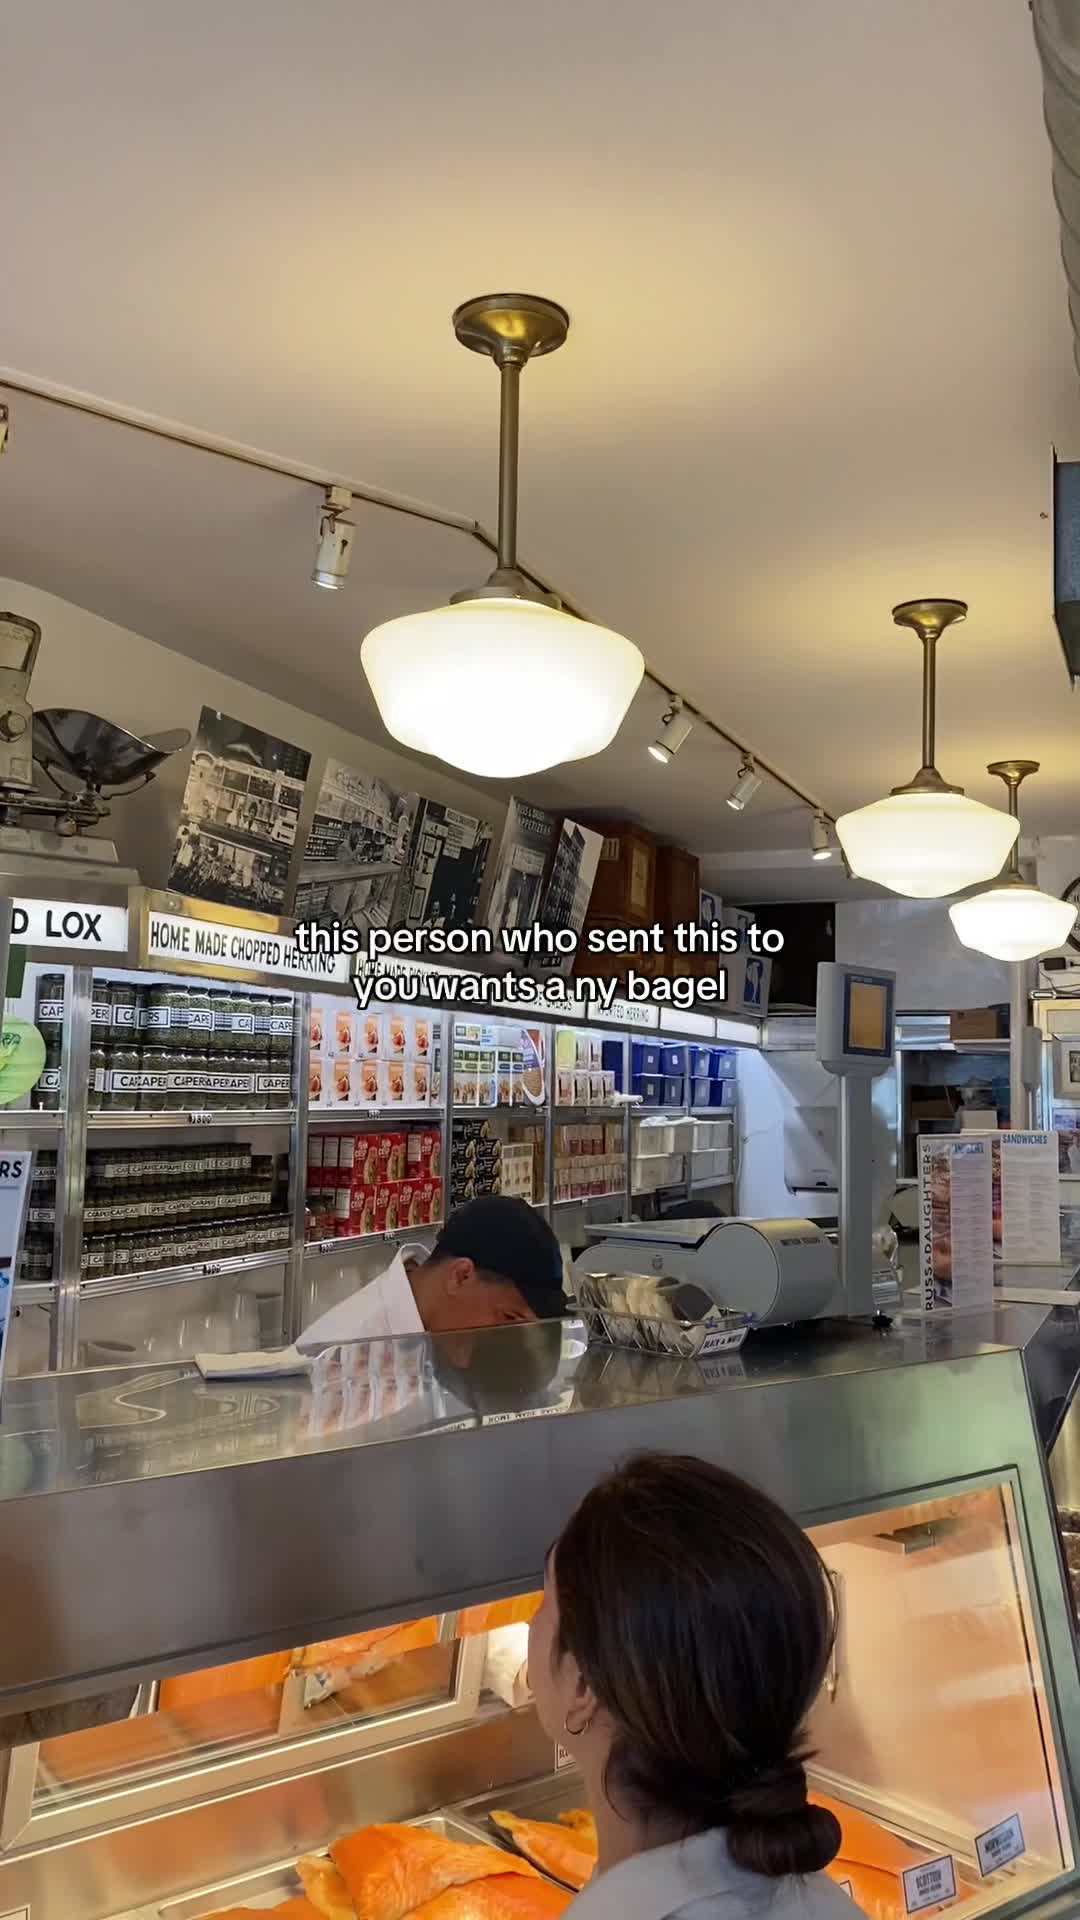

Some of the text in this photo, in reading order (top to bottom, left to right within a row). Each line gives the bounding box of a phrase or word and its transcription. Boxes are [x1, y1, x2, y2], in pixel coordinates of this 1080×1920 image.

[46, 910, 102, 941] LOX
[151, 921, 336, 974] HOME MADE CHOPPED HERRING
[1002, 1134, 1048, 1146] SANDWICHES
